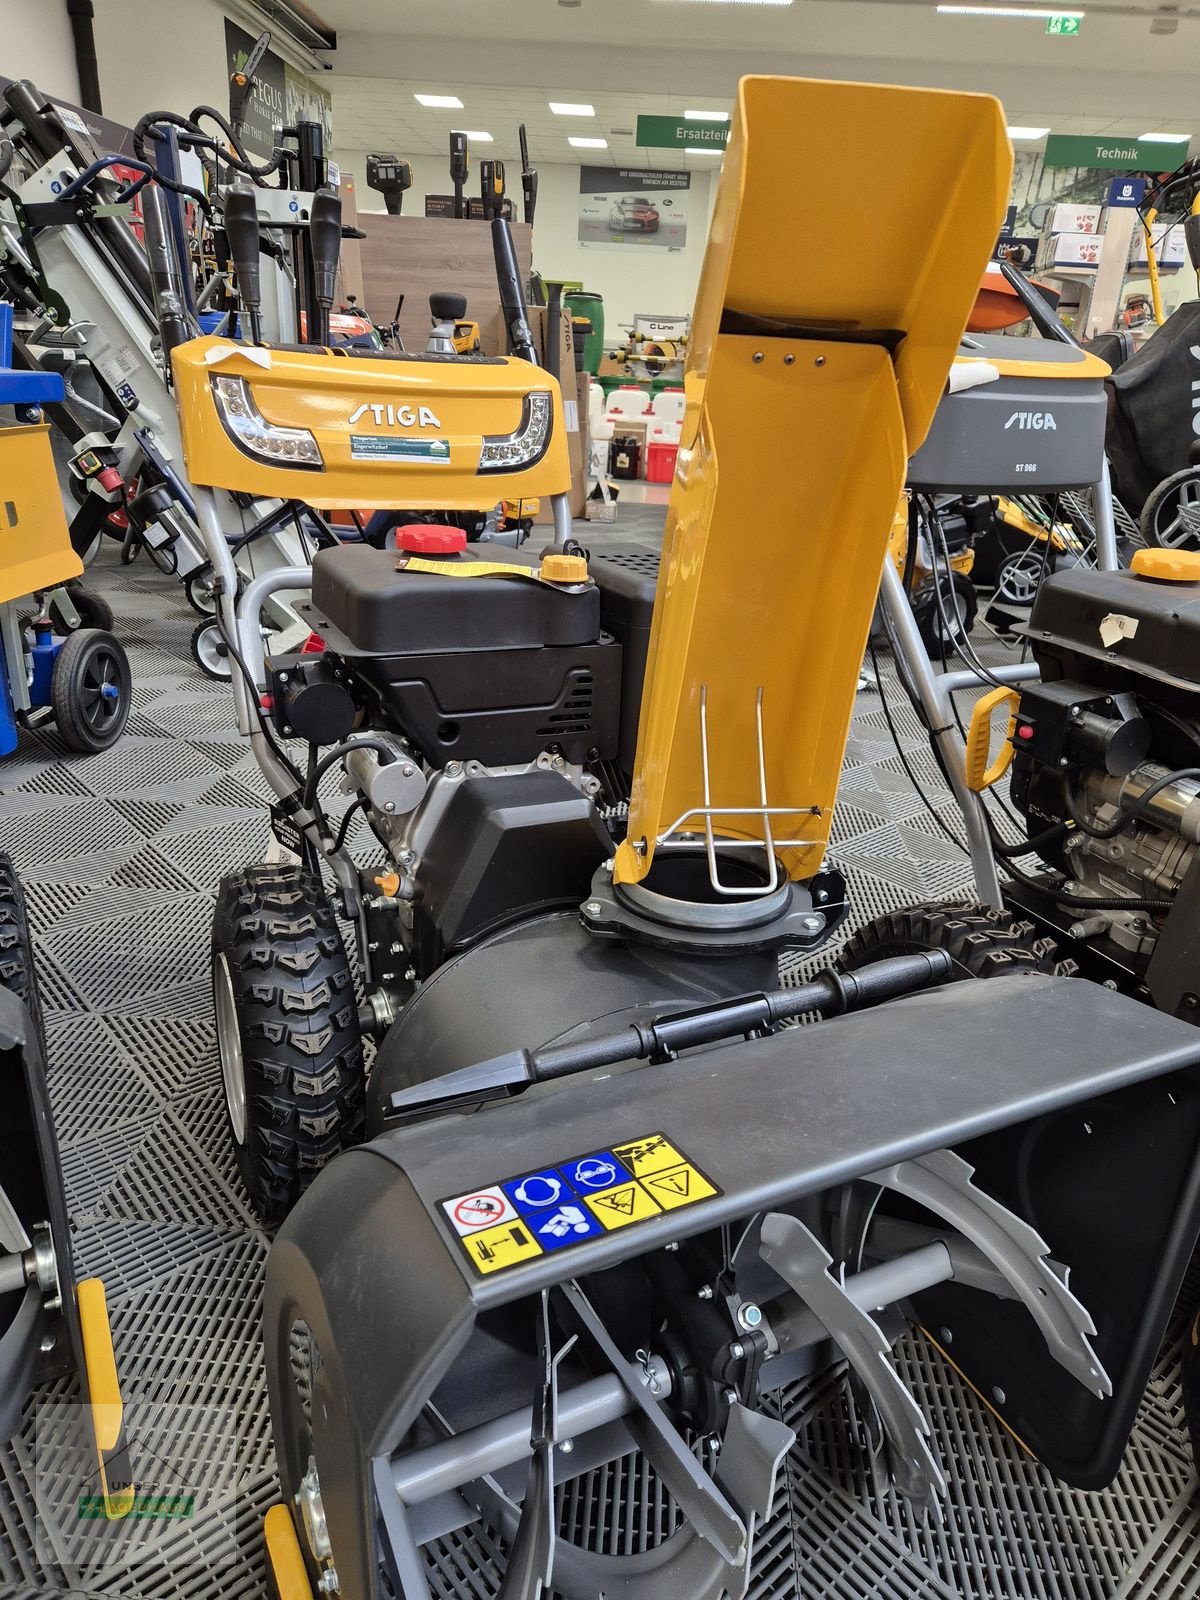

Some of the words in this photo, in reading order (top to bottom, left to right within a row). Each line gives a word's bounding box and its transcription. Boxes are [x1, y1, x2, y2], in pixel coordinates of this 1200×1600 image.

[251, 75, 282, 113] PEGUS
[676, 127, 729, 140] Ersatzteil
[1096, 147, 1138, 159] Technik
[563, 314, 572, 352] STIGA
[348, 404, 440, 429] STIGA
[1004, 412, 1057, 430] STIGA
[1015, 464, 1024, 472] ST
